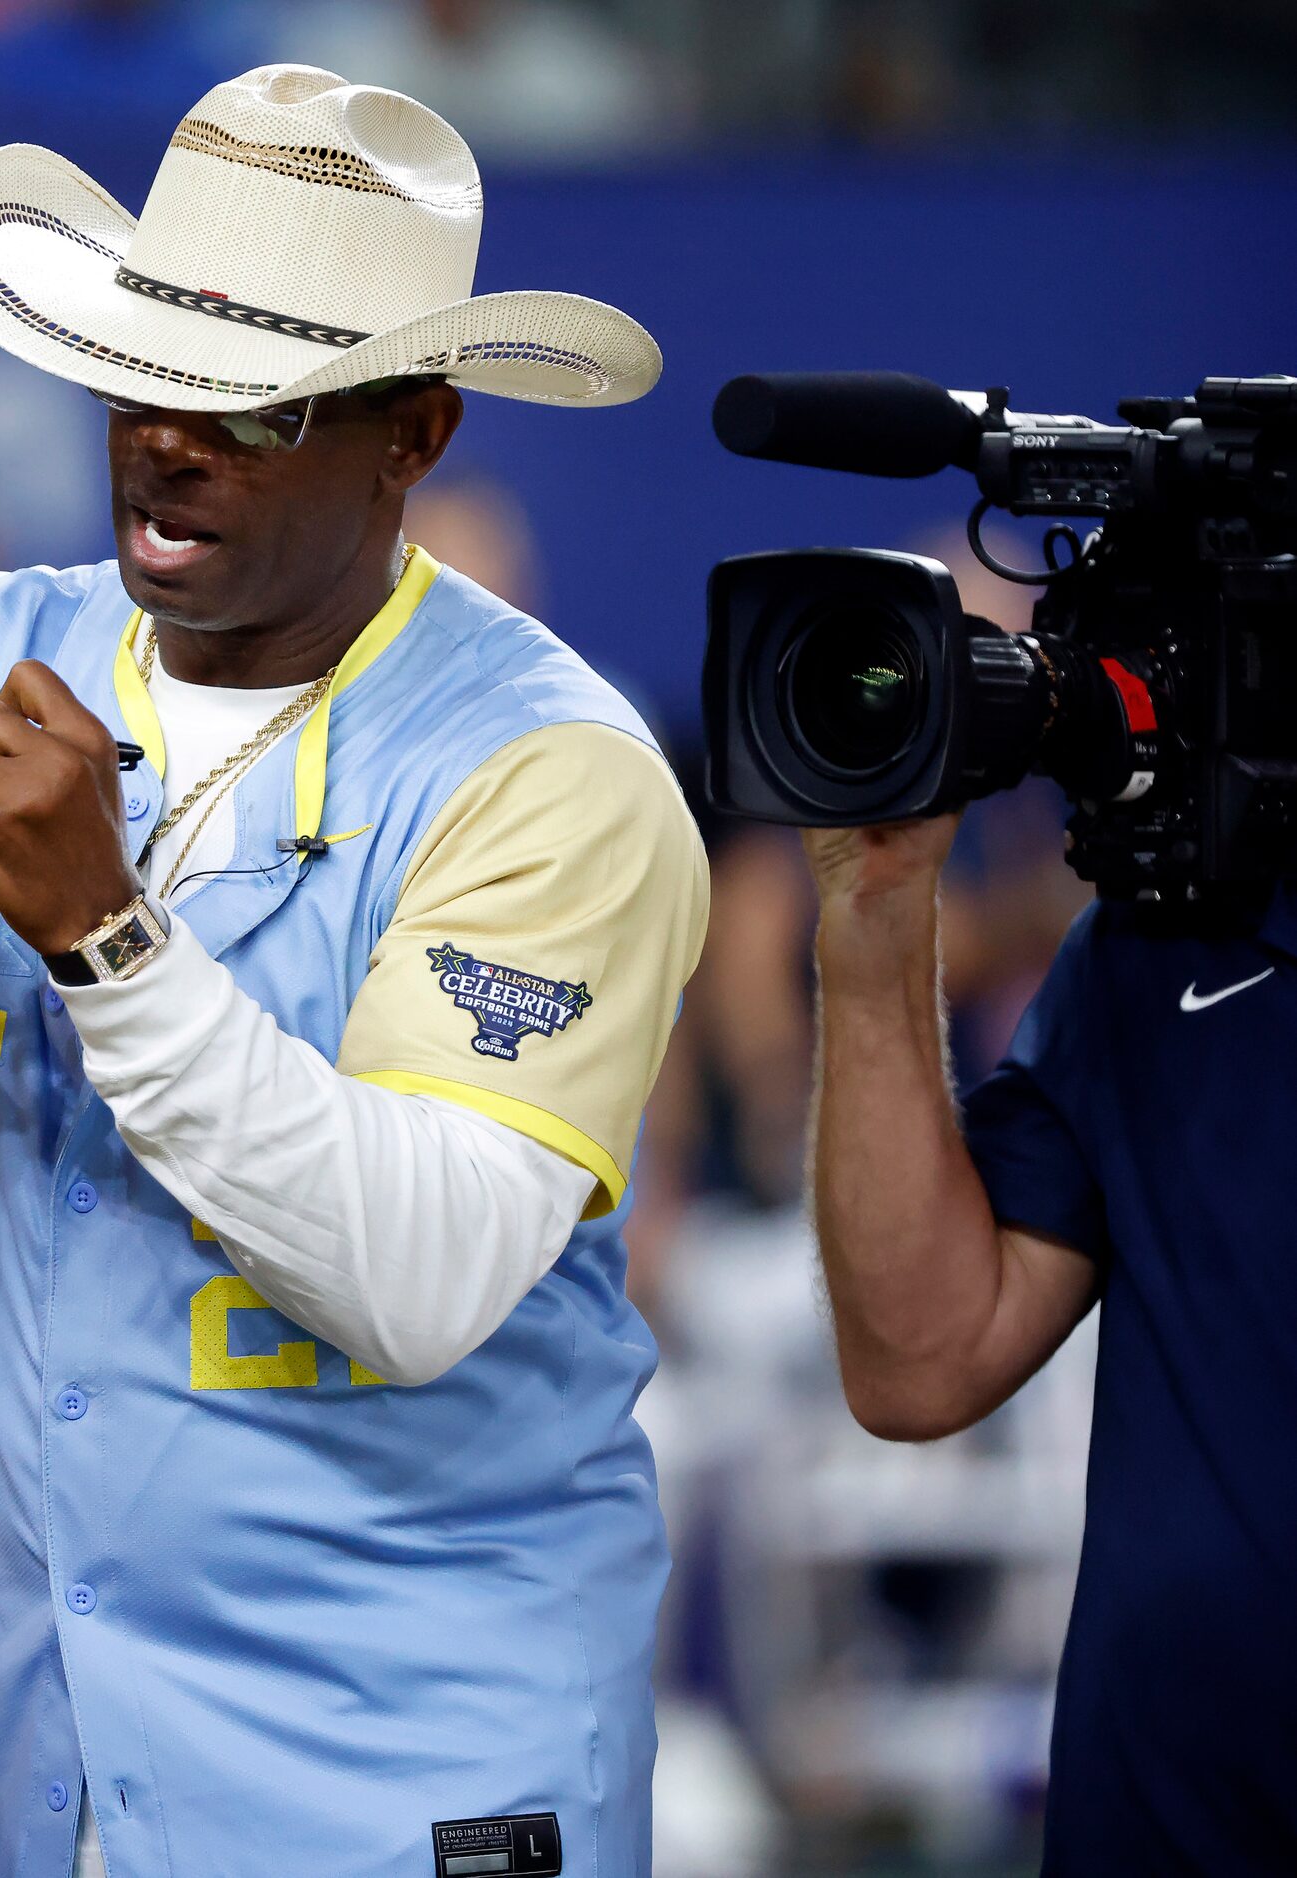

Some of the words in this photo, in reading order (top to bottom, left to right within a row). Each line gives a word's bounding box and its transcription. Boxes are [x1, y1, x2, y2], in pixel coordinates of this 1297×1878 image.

[1012, 434, 1061, 448] SONY
[441, 972, 574, 1027] CELEBRITY
[457, 995, 517, 1019] SOFTBALL
[518, 1013, 551, 1032] GAME
[491, 1014, 514, 1028] 2024
[474, 1038, 514, 1058] Corona
[441, 1826, 507, 1839] ENGINEERED
[529, 1834, 542, 1857] L
